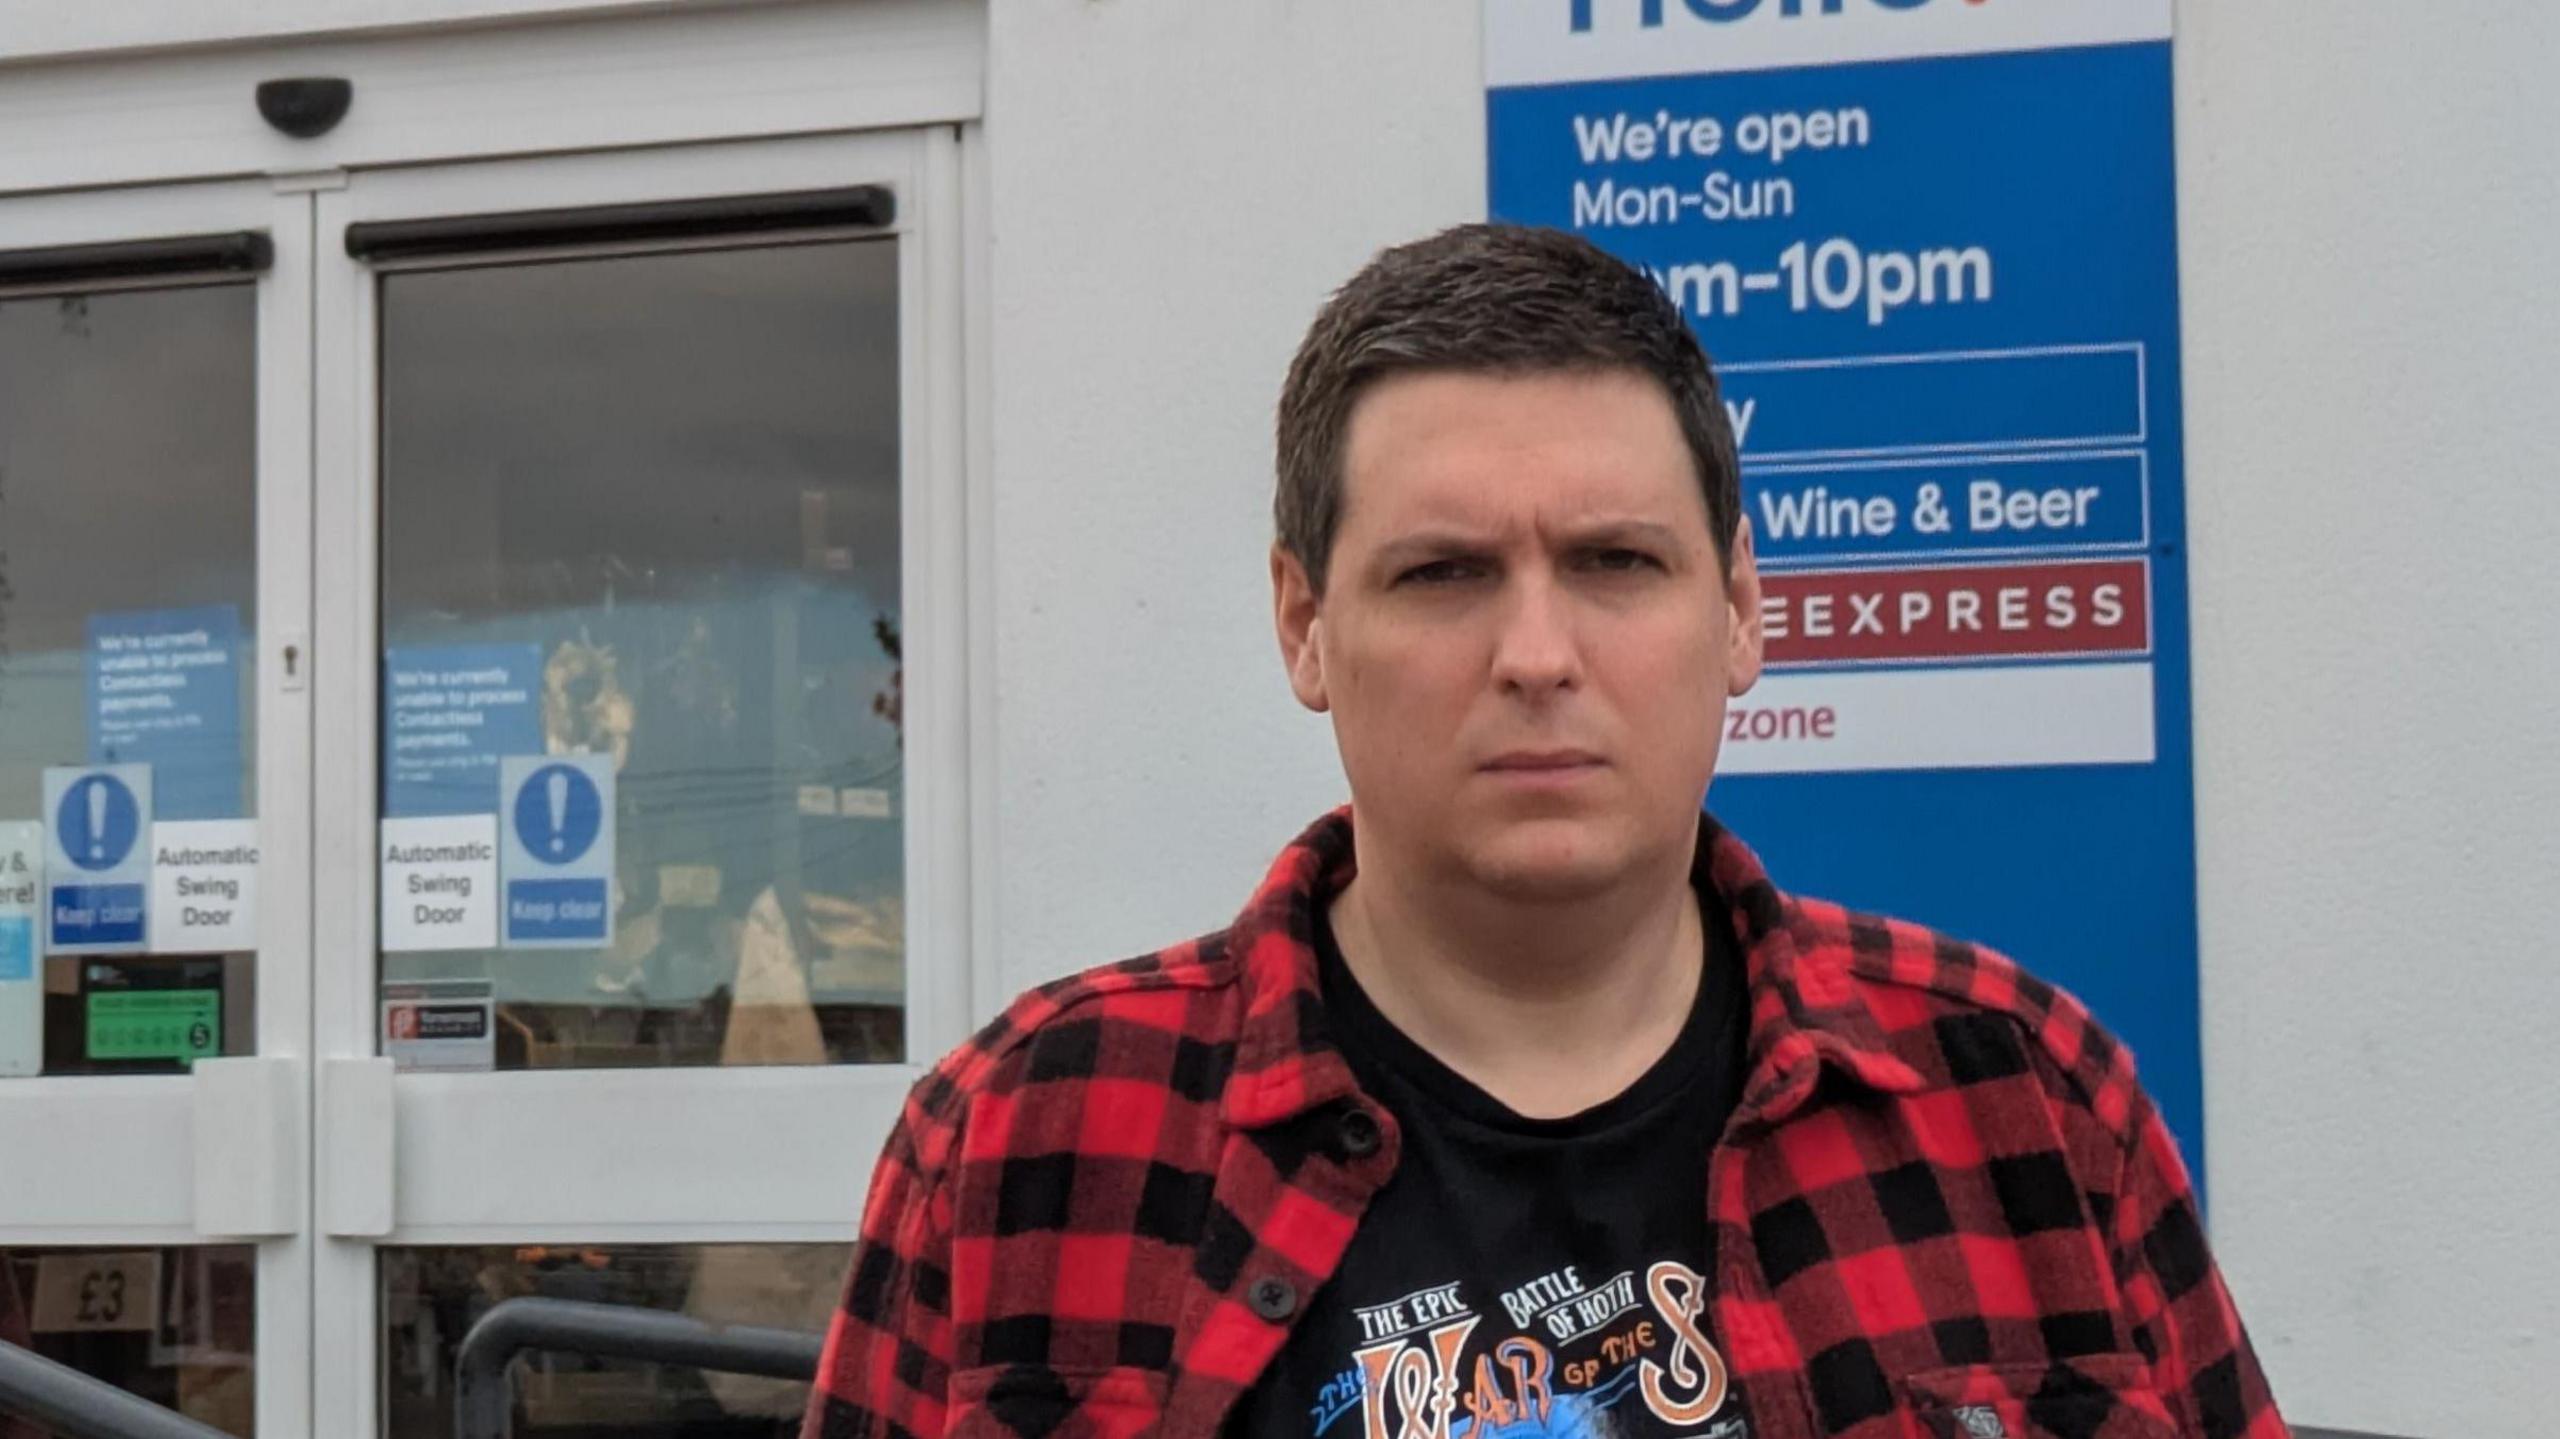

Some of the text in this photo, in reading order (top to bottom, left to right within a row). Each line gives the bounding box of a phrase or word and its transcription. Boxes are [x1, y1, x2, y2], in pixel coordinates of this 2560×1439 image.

[1573, 106, 1869, 163] We're open
[1652, 238, 1993, 325] m-10pm
[1759, 479, 2100, 539] Wine & Beer
[156, 845, 259, 867] Automatic
[387, 842, 492, 865] Automatic
[176, 875, 239, 900] Swing
[408, 873, 472, 898] Swing
[181, 905, 233, 926] Door
[414, 904, 465, 925] Door
[78, 1270, 125, 1322] £3
[1500, 1266, 1586, 1330] BATTLE
[1357, 1287, 1469, 1340] THE EPIC
[1546, 1310, 1577, 1339] OF
